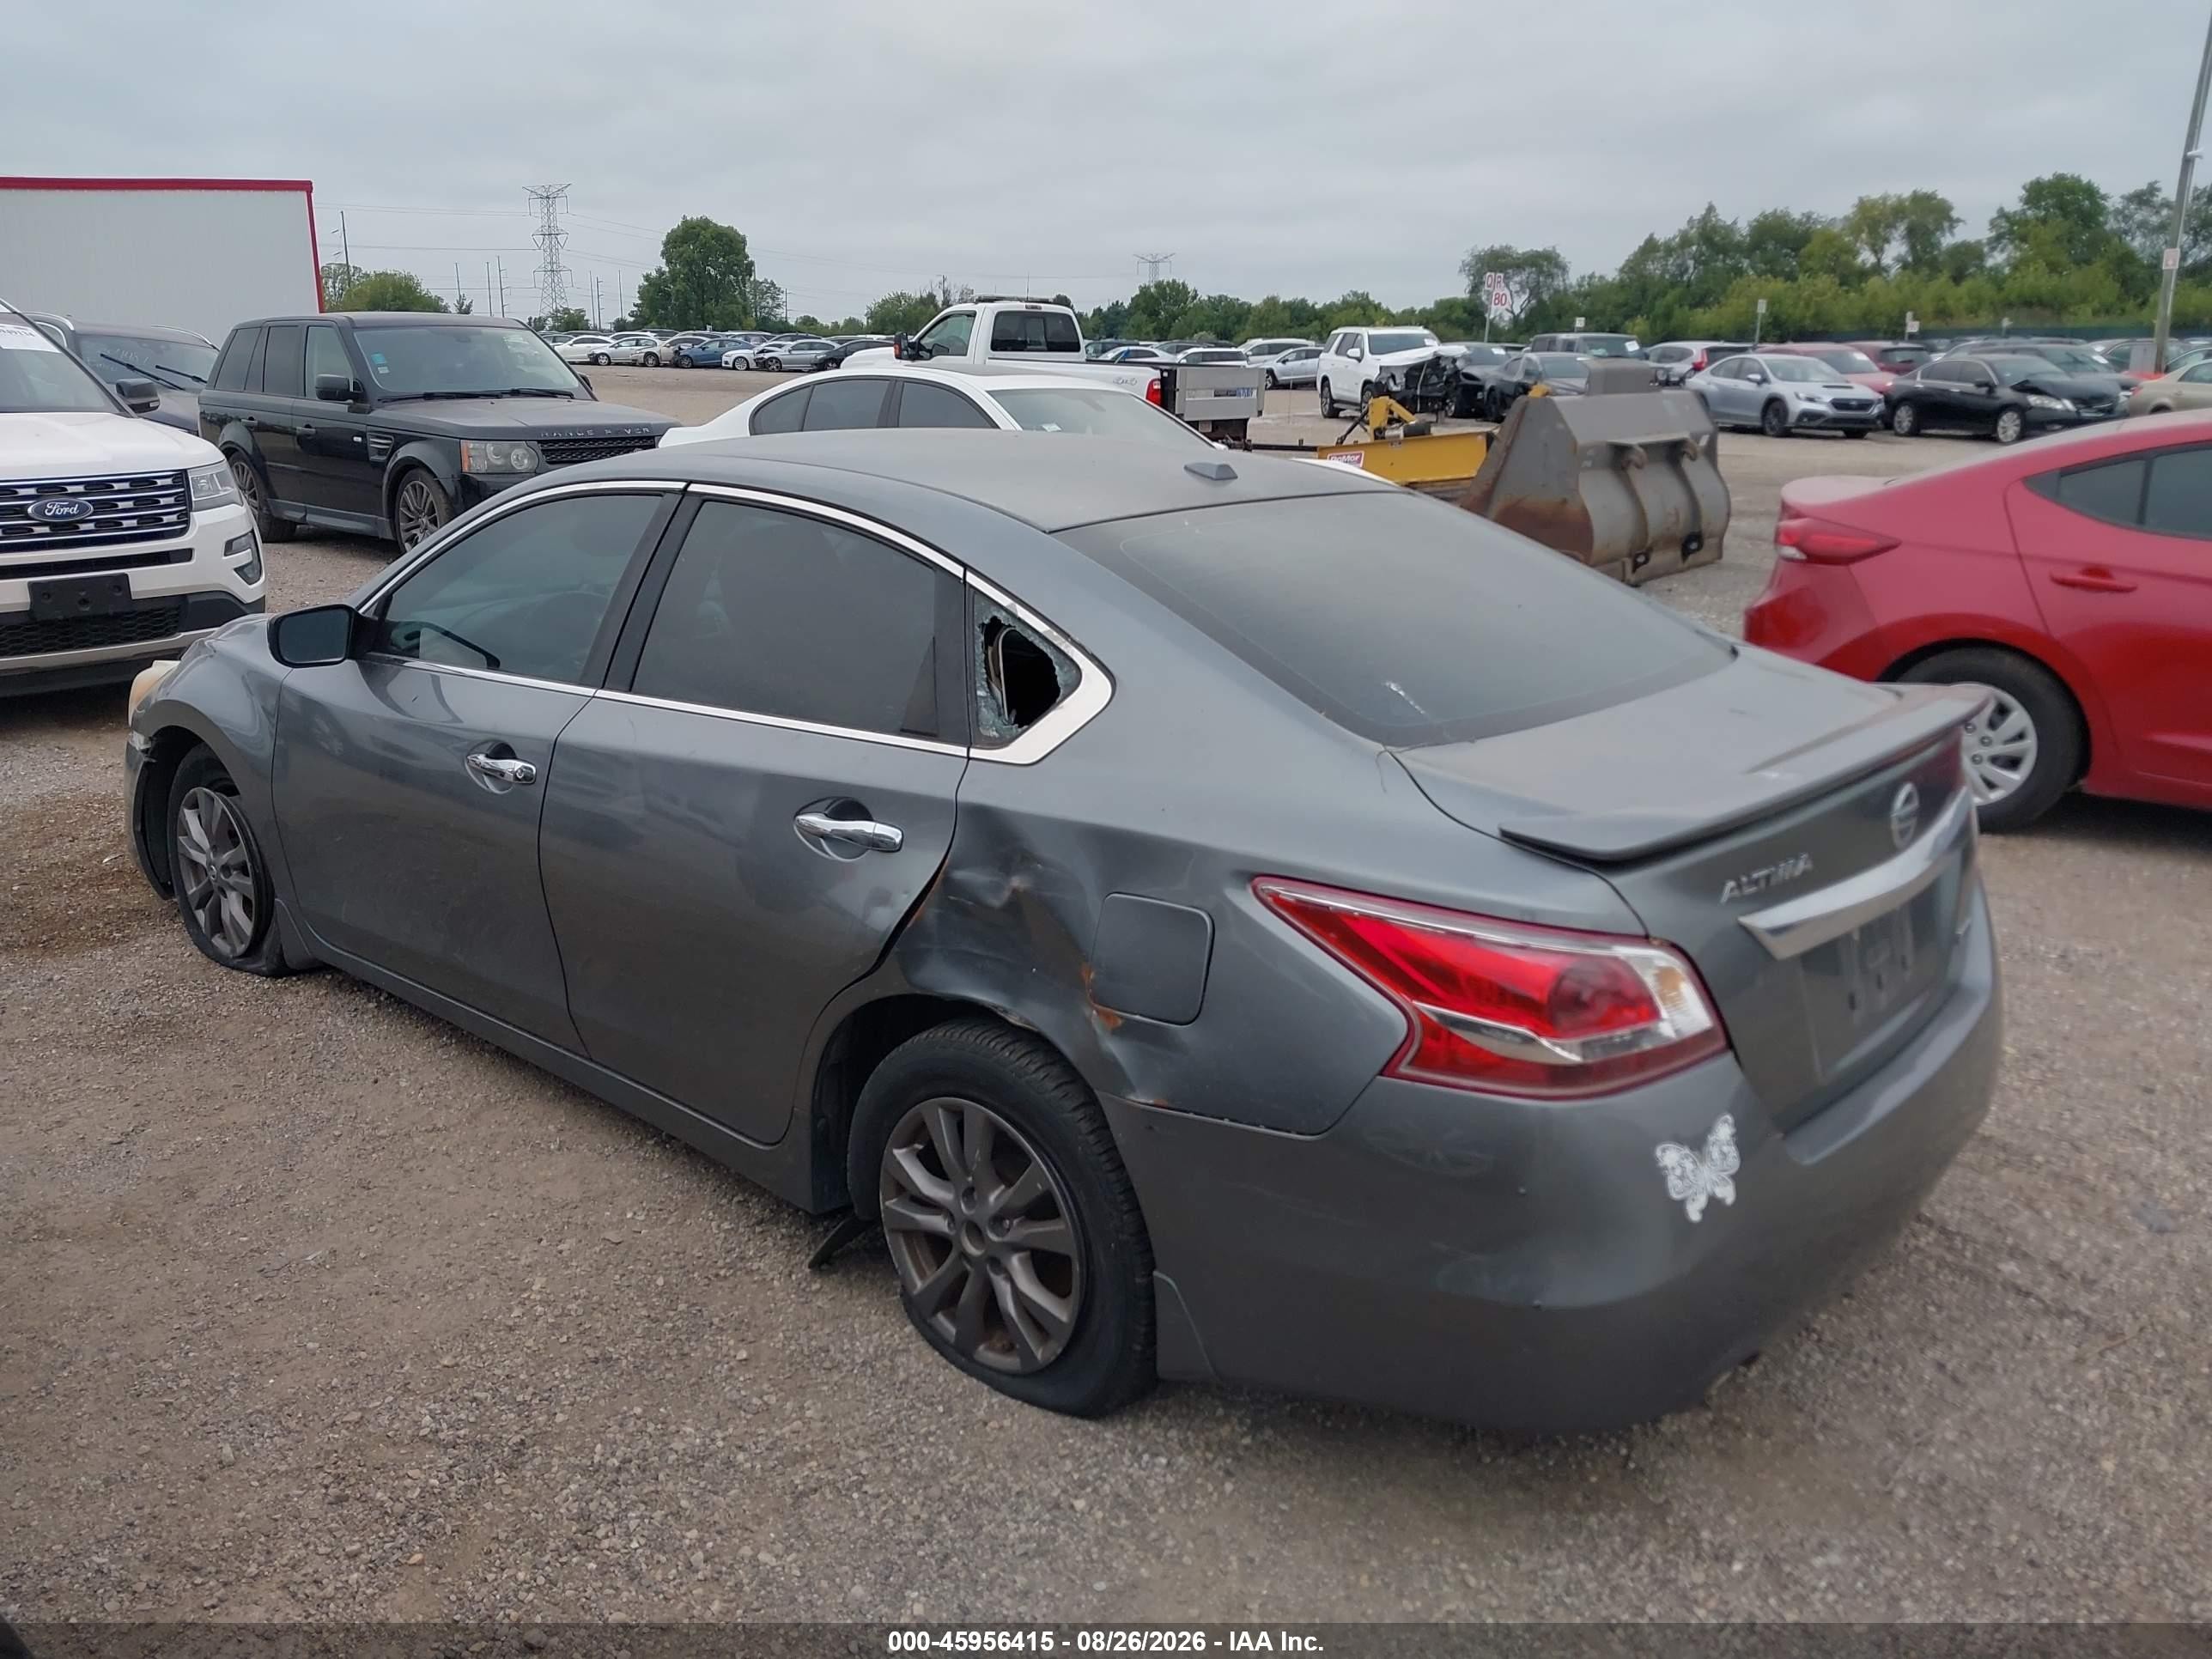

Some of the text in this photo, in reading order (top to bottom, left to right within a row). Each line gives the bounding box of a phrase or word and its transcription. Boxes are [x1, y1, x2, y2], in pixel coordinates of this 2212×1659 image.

[1493, 292, 1507, 307] 80
[45, 501, 79, 516] Ford
[1719, 851, 1813, 904] ALTIMA
